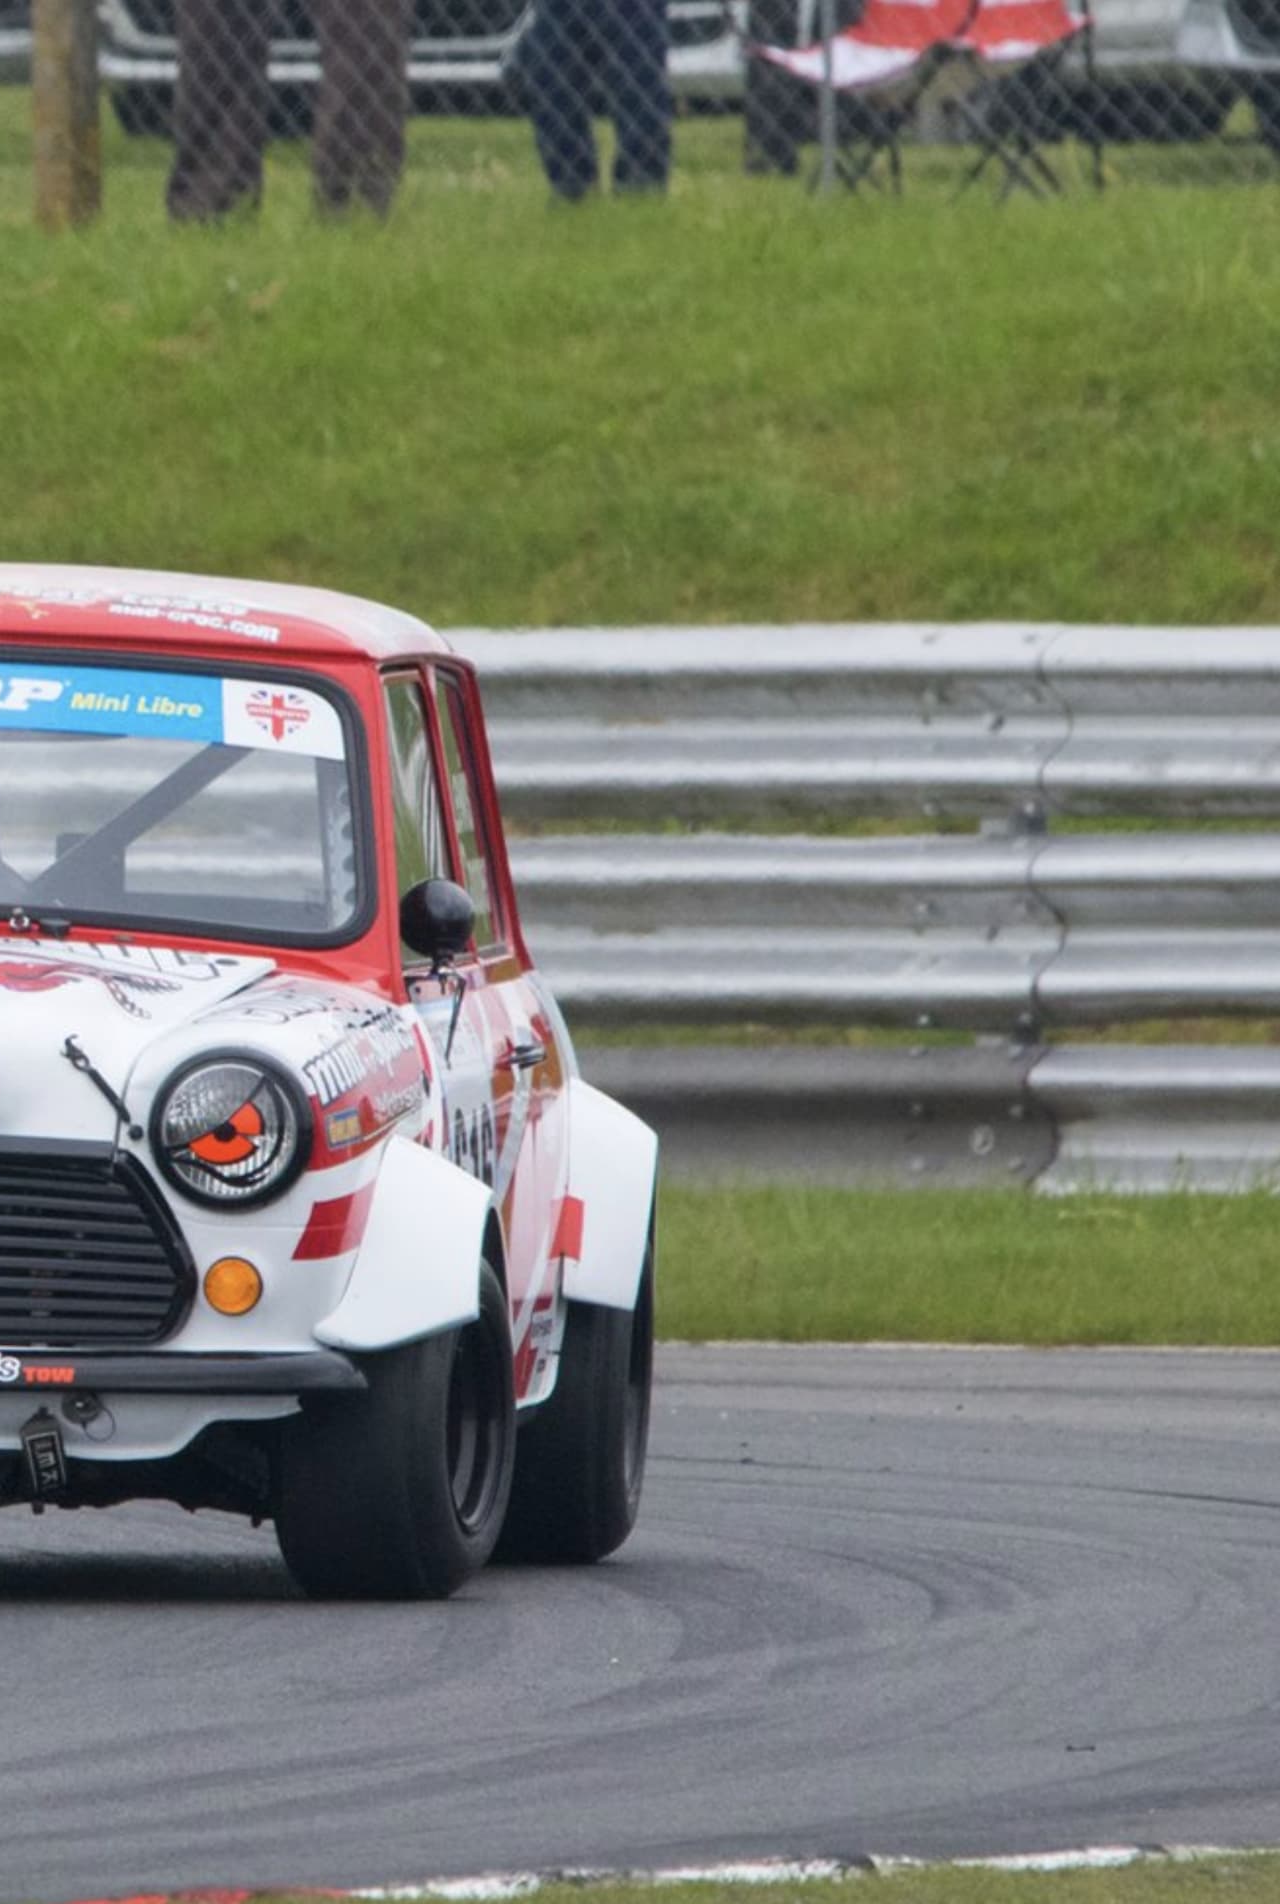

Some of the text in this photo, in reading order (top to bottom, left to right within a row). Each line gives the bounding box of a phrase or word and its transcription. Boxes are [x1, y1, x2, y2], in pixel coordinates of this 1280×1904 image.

[70, 692, 133, 713] Mini
[138, 696, 204, 718] Libre
[24, 1368, 76, 1384] TOW
